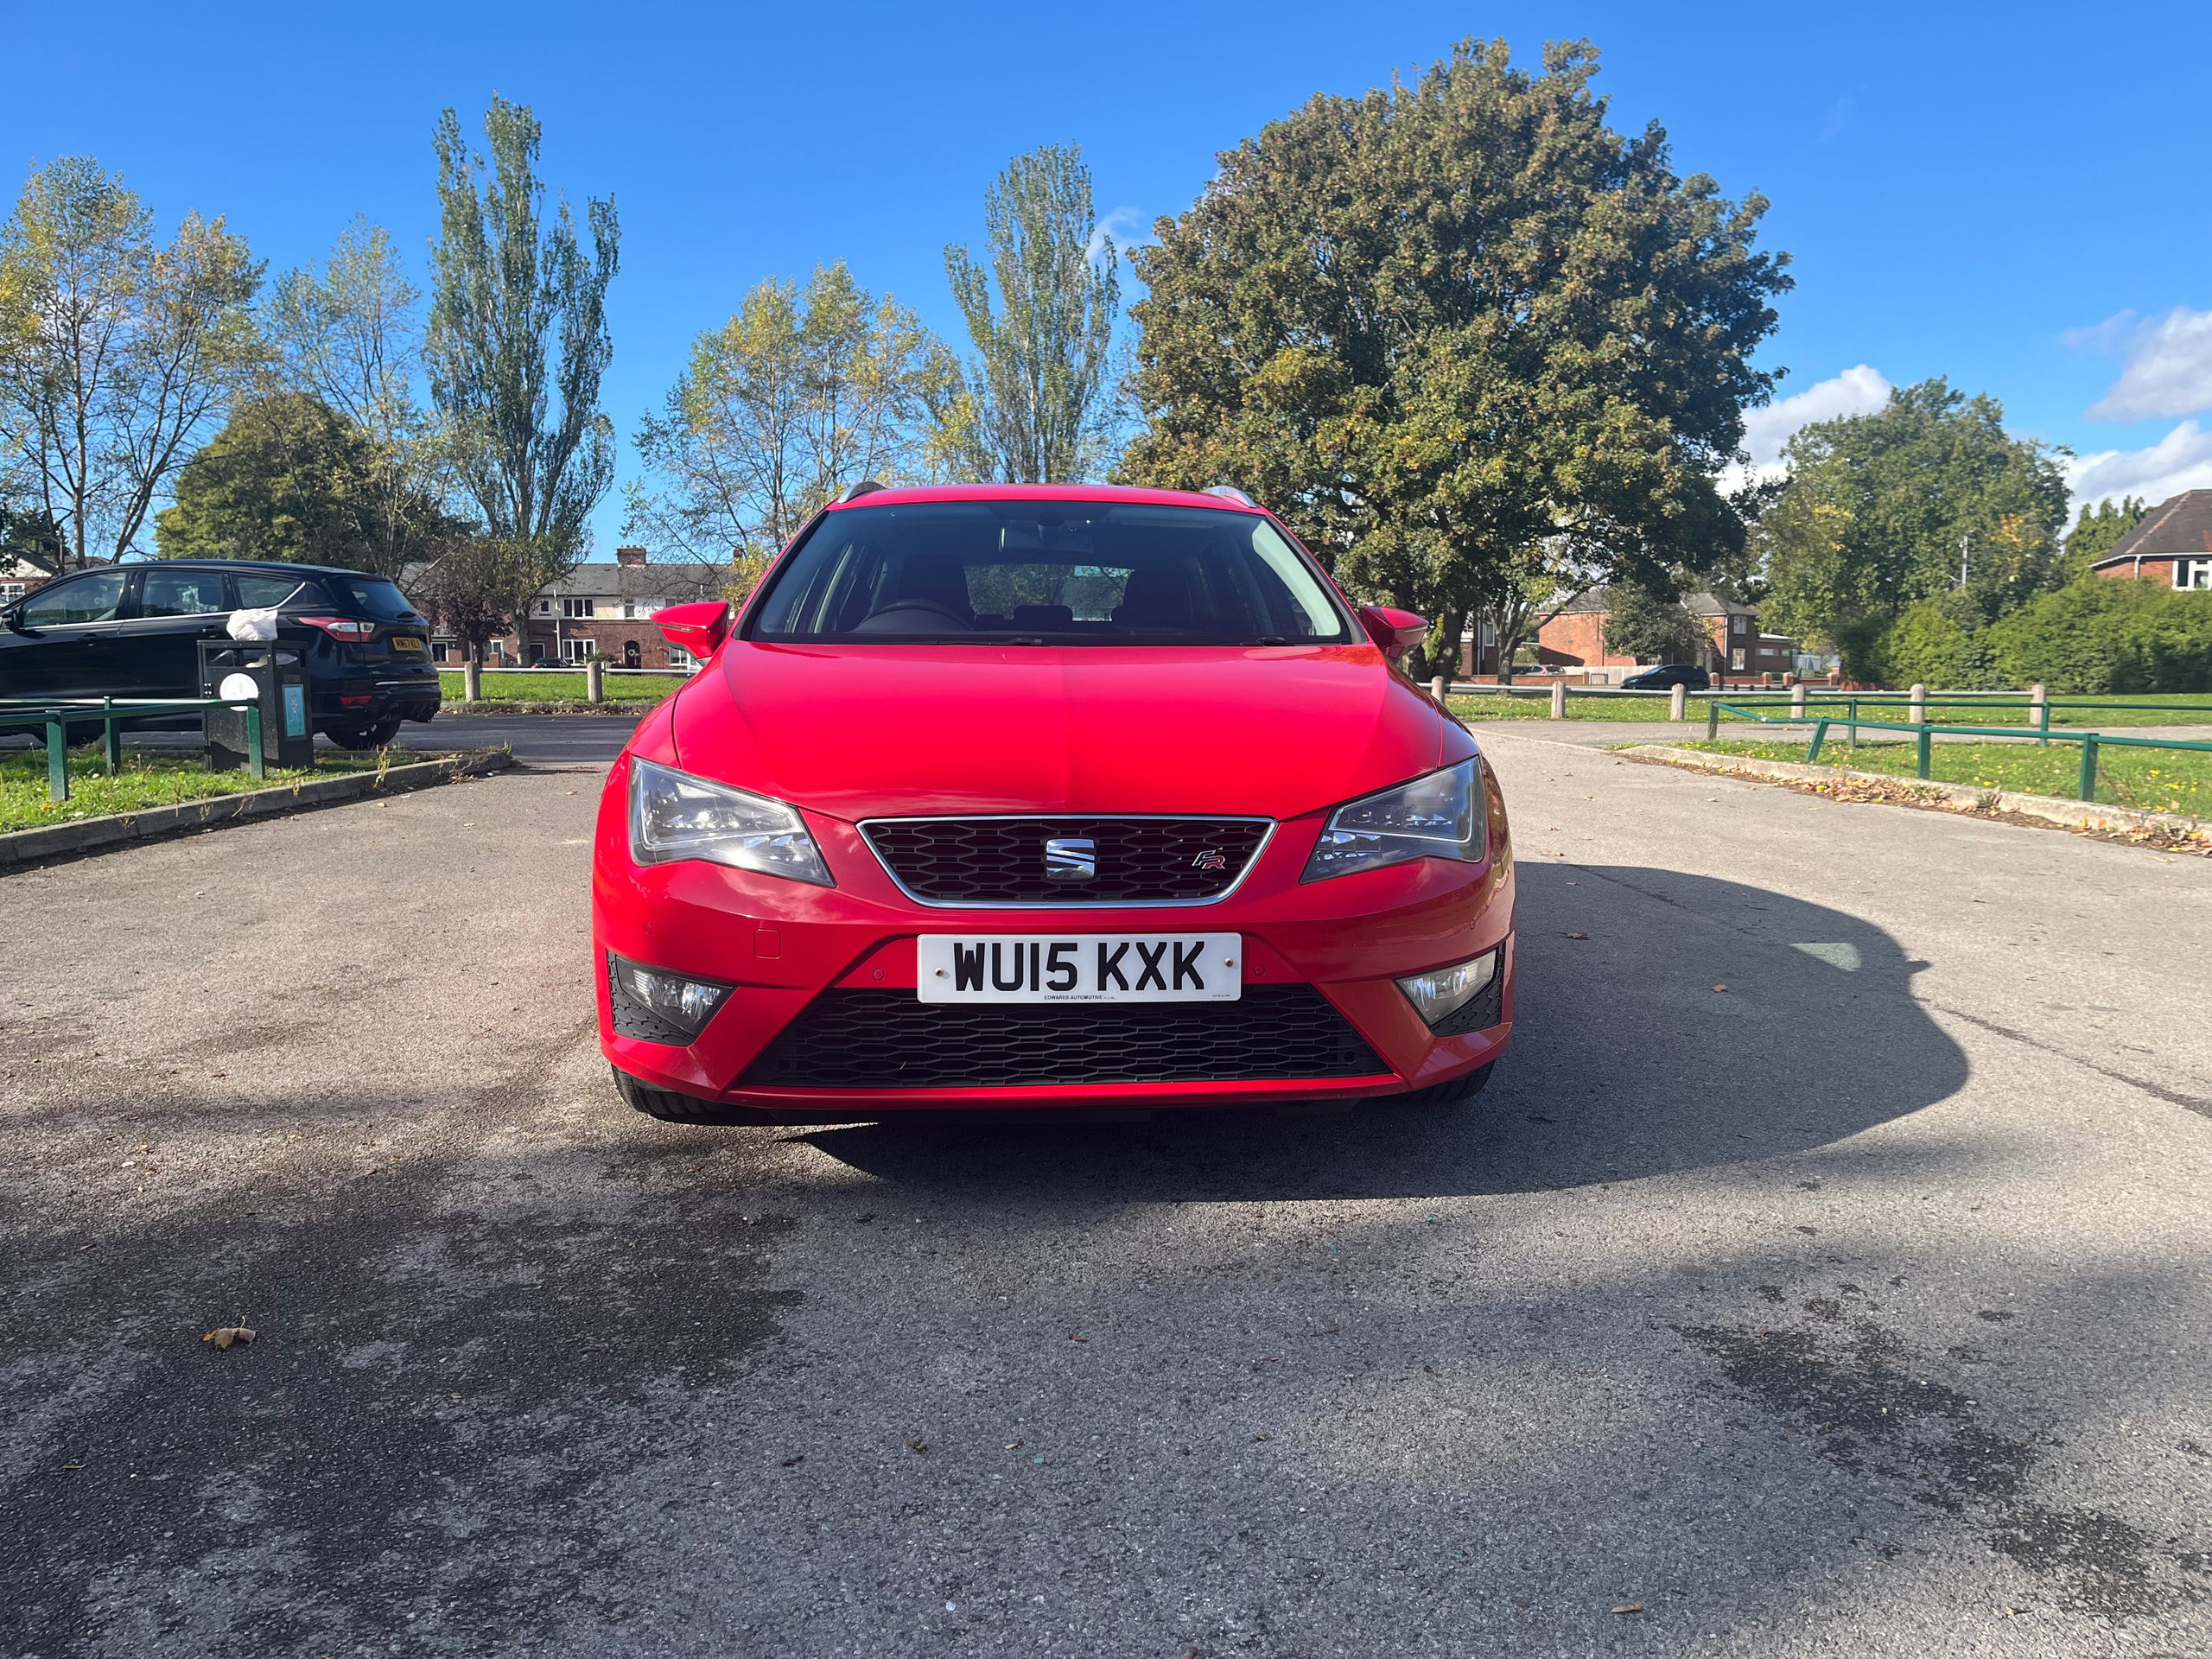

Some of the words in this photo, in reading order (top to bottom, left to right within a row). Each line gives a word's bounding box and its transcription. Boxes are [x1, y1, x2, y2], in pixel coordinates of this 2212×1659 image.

[1192, 849, 1226, 870] FR
[953, 942, 1078, 992] WU15
[1097, 941, 1205, 991] KXK
